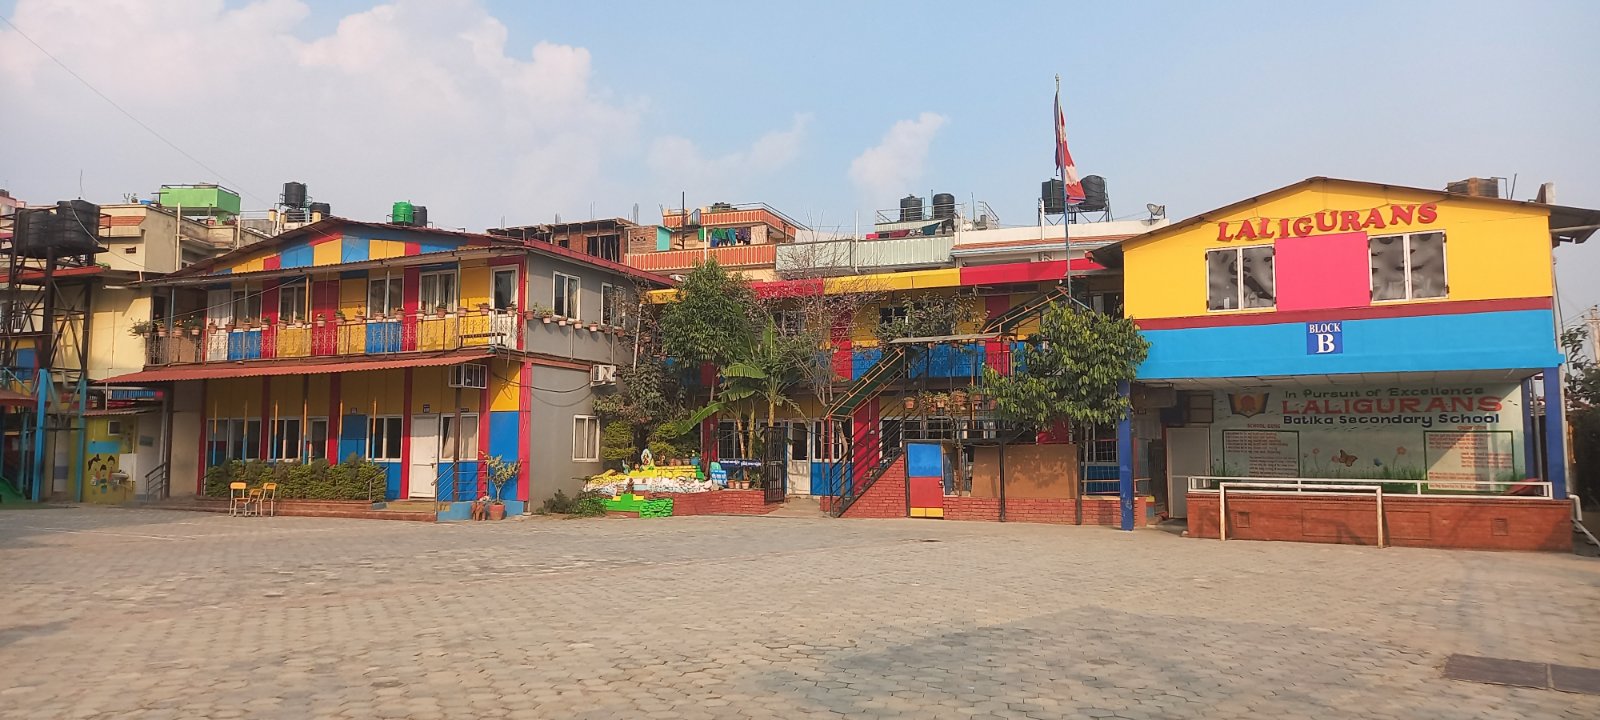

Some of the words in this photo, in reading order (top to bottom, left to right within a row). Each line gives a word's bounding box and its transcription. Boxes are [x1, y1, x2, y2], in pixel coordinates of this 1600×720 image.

[1216, 203, 1438, 242] LALIGURANS
[1309, 322, 1341, 334] BLOCK
[1315, 333, 1335, 354] B
[1285, 390, 1297, 398] In
[1303, 389, 1360, 398] Pursuit
[1366, 388, 1381, 397] of
[1387, 387, 1485, 396] Excellence
[1282, 396, 1503, 414] LALIGURANS
[1283, 415, 1334, 425] Batika
[1339, 414, 1433, 428] Secondary
[1438, 413, 1500, 424] School
